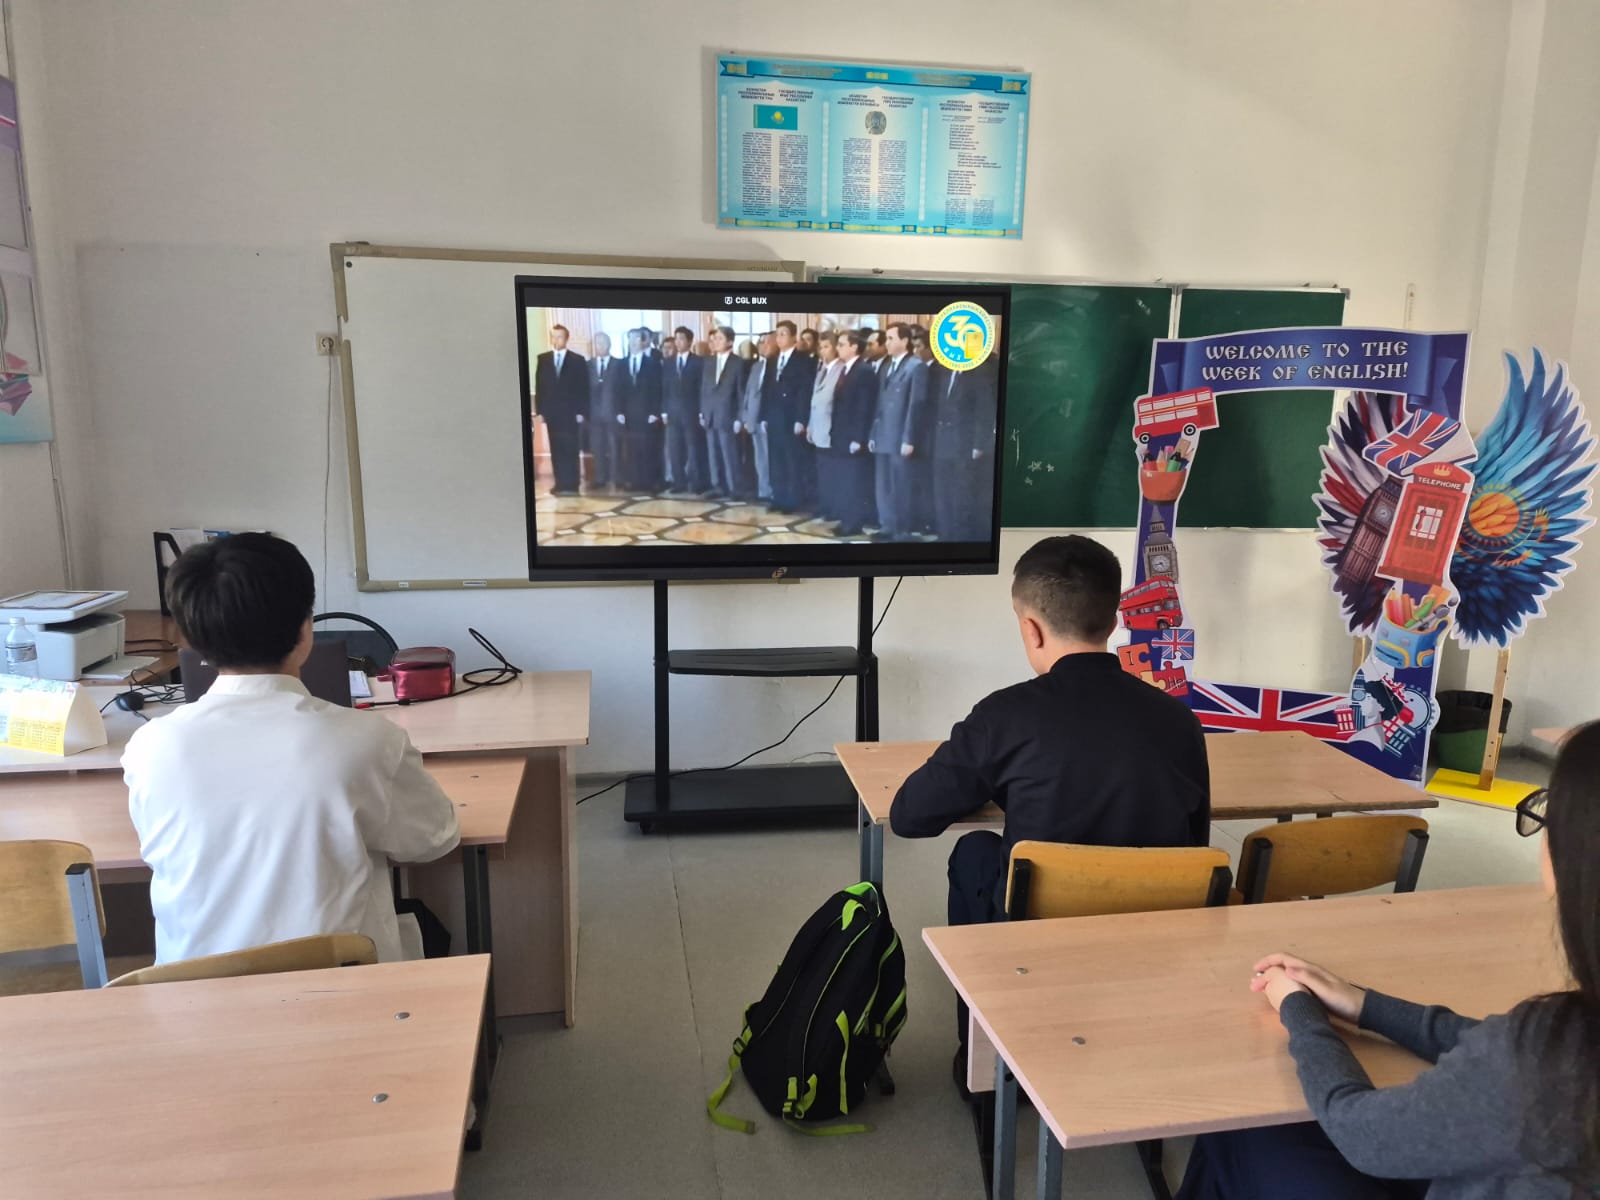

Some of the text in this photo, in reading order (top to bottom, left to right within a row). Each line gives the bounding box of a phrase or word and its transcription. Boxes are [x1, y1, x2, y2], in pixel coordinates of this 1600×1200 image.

[735, 296, 751, 305] CGL
[1205, 341, 1409, 360] WELCOME TO THE
[1202, 361, 1409, 381] WEEK OF ENGLISH!
[1418, 477, 1462, 490] TELEPHONE
